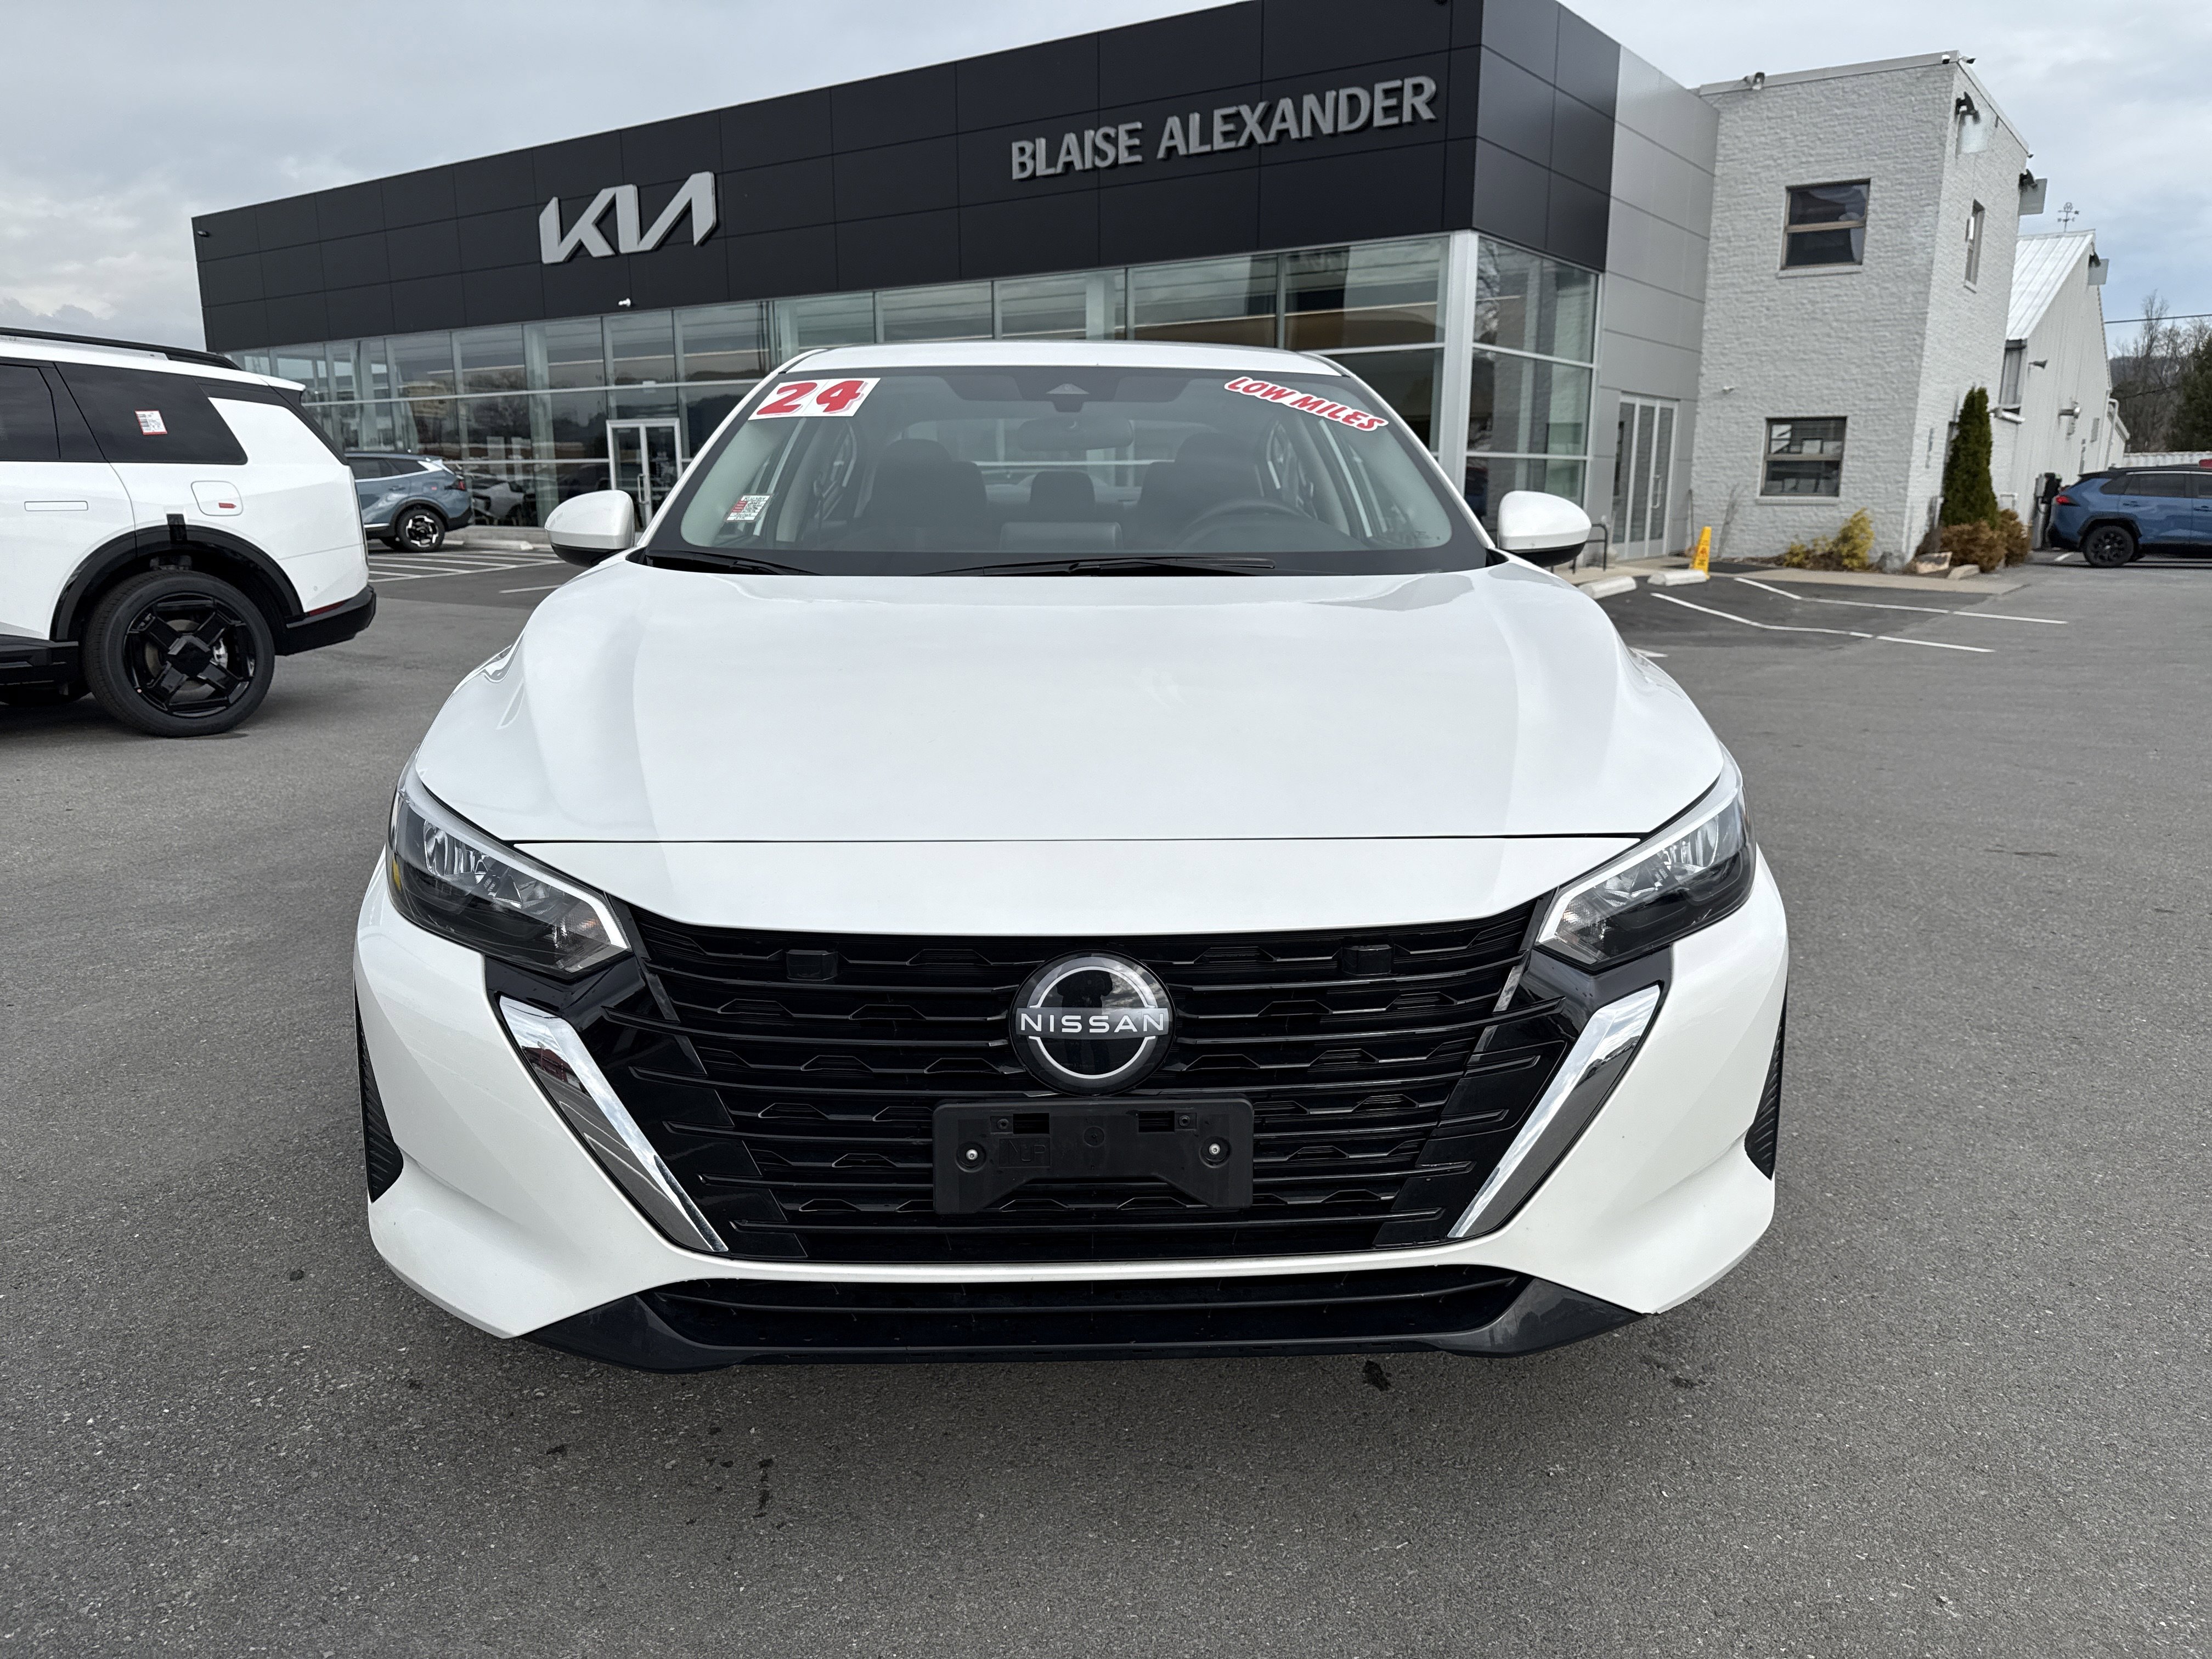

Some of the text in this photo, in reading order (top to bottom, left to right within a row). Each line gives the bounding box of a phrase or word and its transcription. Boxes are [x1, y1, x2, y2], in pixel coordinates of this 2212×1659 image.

[1011, 75, 1438, 180] BLAISE ALEXANDER
[539, 171, 716, 264] KIA
[756, 380, 868, 416] 24
[1227, 377, 1385, 430] LOW MILES
[1020, 1013, 1164, 1033] NISSAN
[1020, 1144, 1046, 1162] UP
